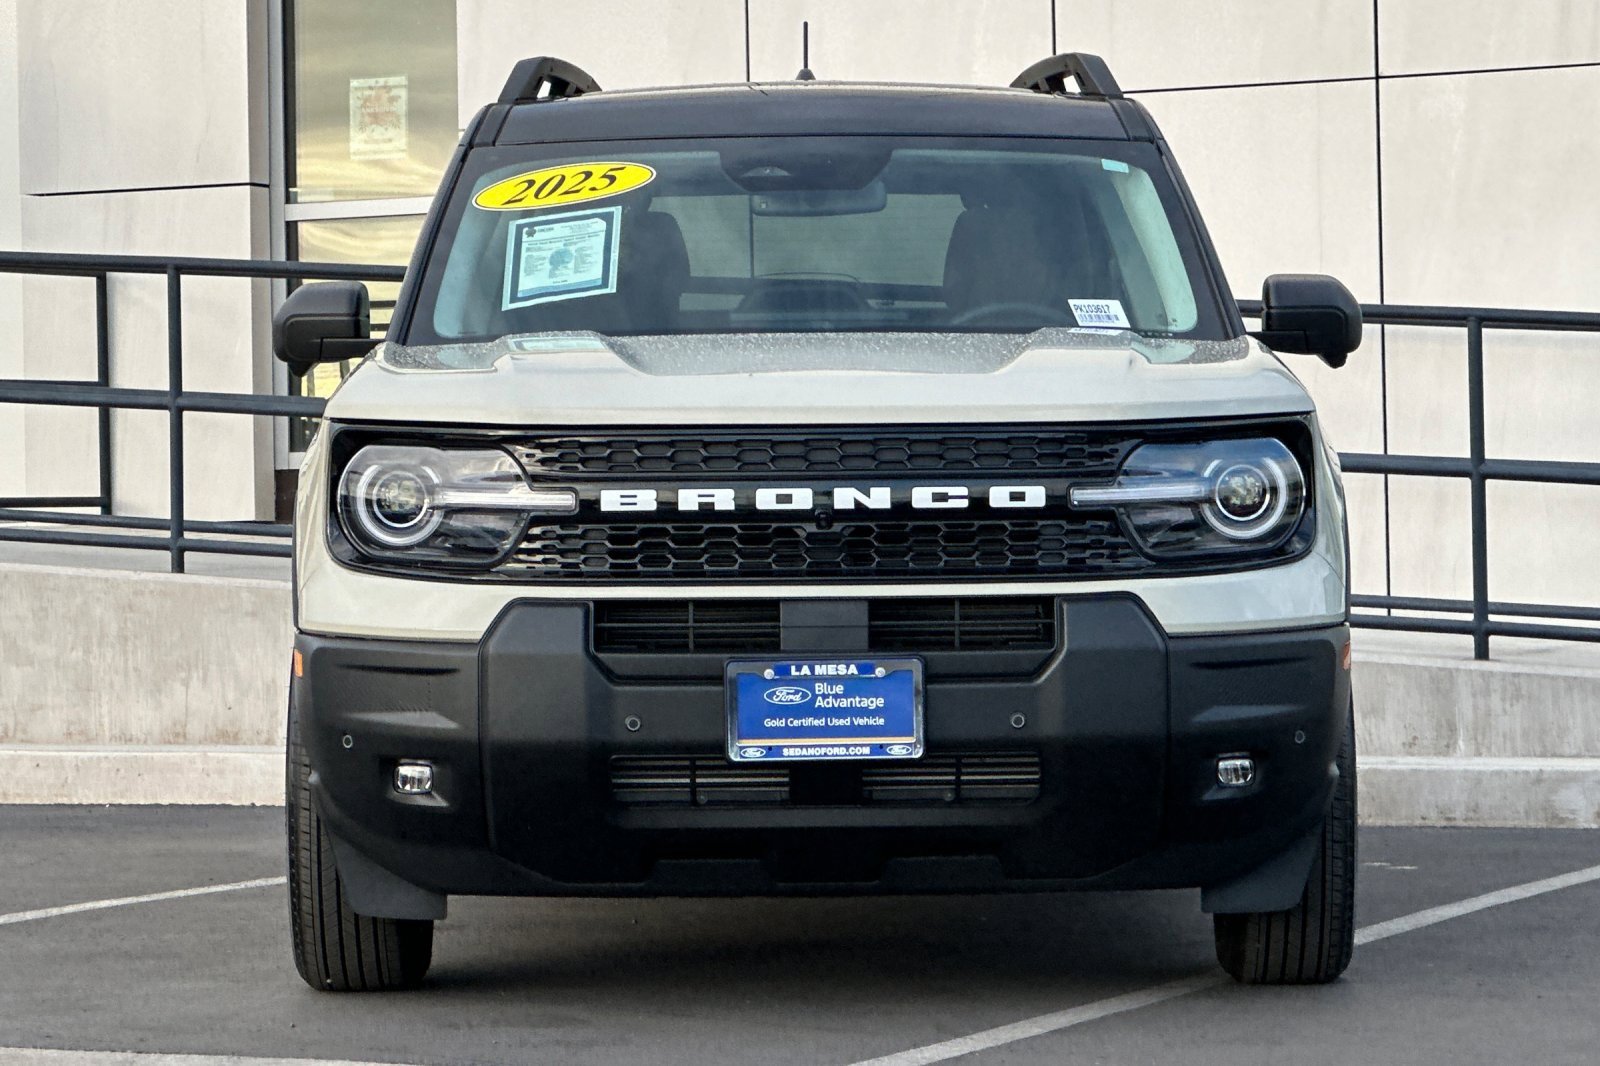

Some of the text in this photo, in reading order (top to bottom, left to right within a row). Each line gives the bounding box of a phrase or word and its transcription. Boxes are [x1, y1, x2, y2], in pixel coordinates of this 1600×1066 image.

[501, 166, 627, 206] 2025
[1073, 304, 1111, 314] PK103617
[600, 486, 1046, 512] BRONCO
[790, 664, 858, 676] LA MESA
[815, 683, 844, 695] Blue
[772, 689, 802, 702] Ford
[814, 696, 885, 709] Advantage
[764, 716, 885, 727] Gold Certified Used Vehicle
[782, 747, 871, 756] SEDANOFORD.COM
